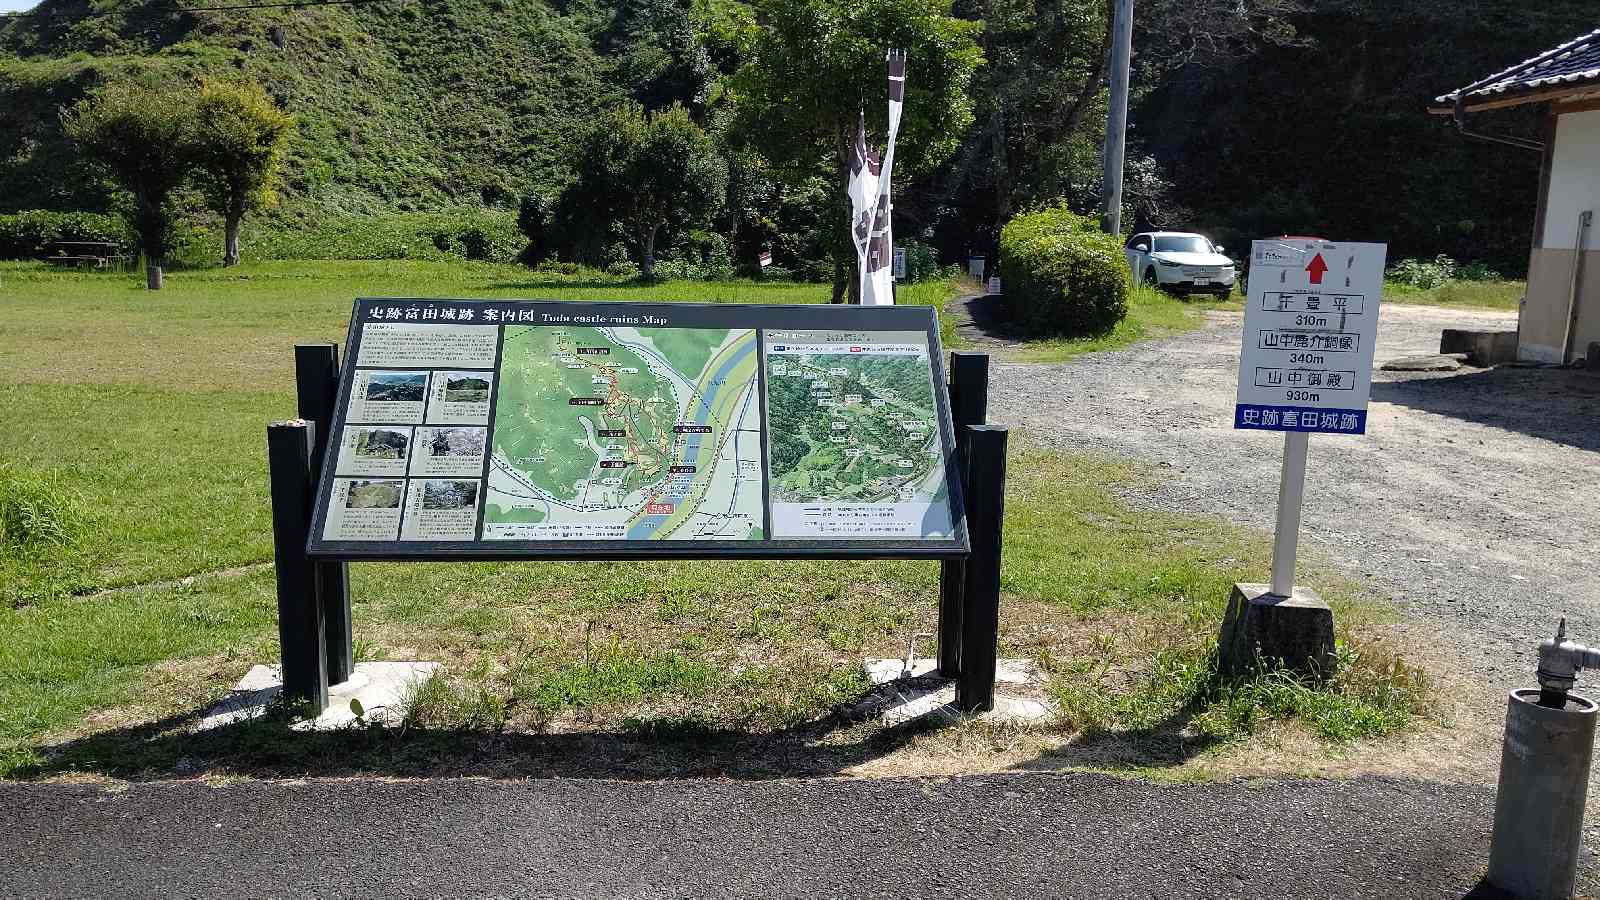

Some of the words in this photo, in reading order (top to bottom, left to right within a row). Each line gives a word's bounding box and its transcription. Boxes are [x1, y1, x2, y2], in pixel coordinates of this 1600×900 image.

[481, 308, 534, 321] 案内図
[574, 314, 607, 323] castle
[610, 315, 639, 324] ruins
[642, 315, 667, 326] Map
[1296, 315, 1327, 326] 310m
[1265, 333, 1353, 349] 山中鹿介銅像
[1290, 353, 1324, 364] 340m
[1268, 371, 1342, 387] 山中御殿
[1286, 391, 1320, 401] 930m
[1242, 409, 1358, 430] 史跡富田城跡
